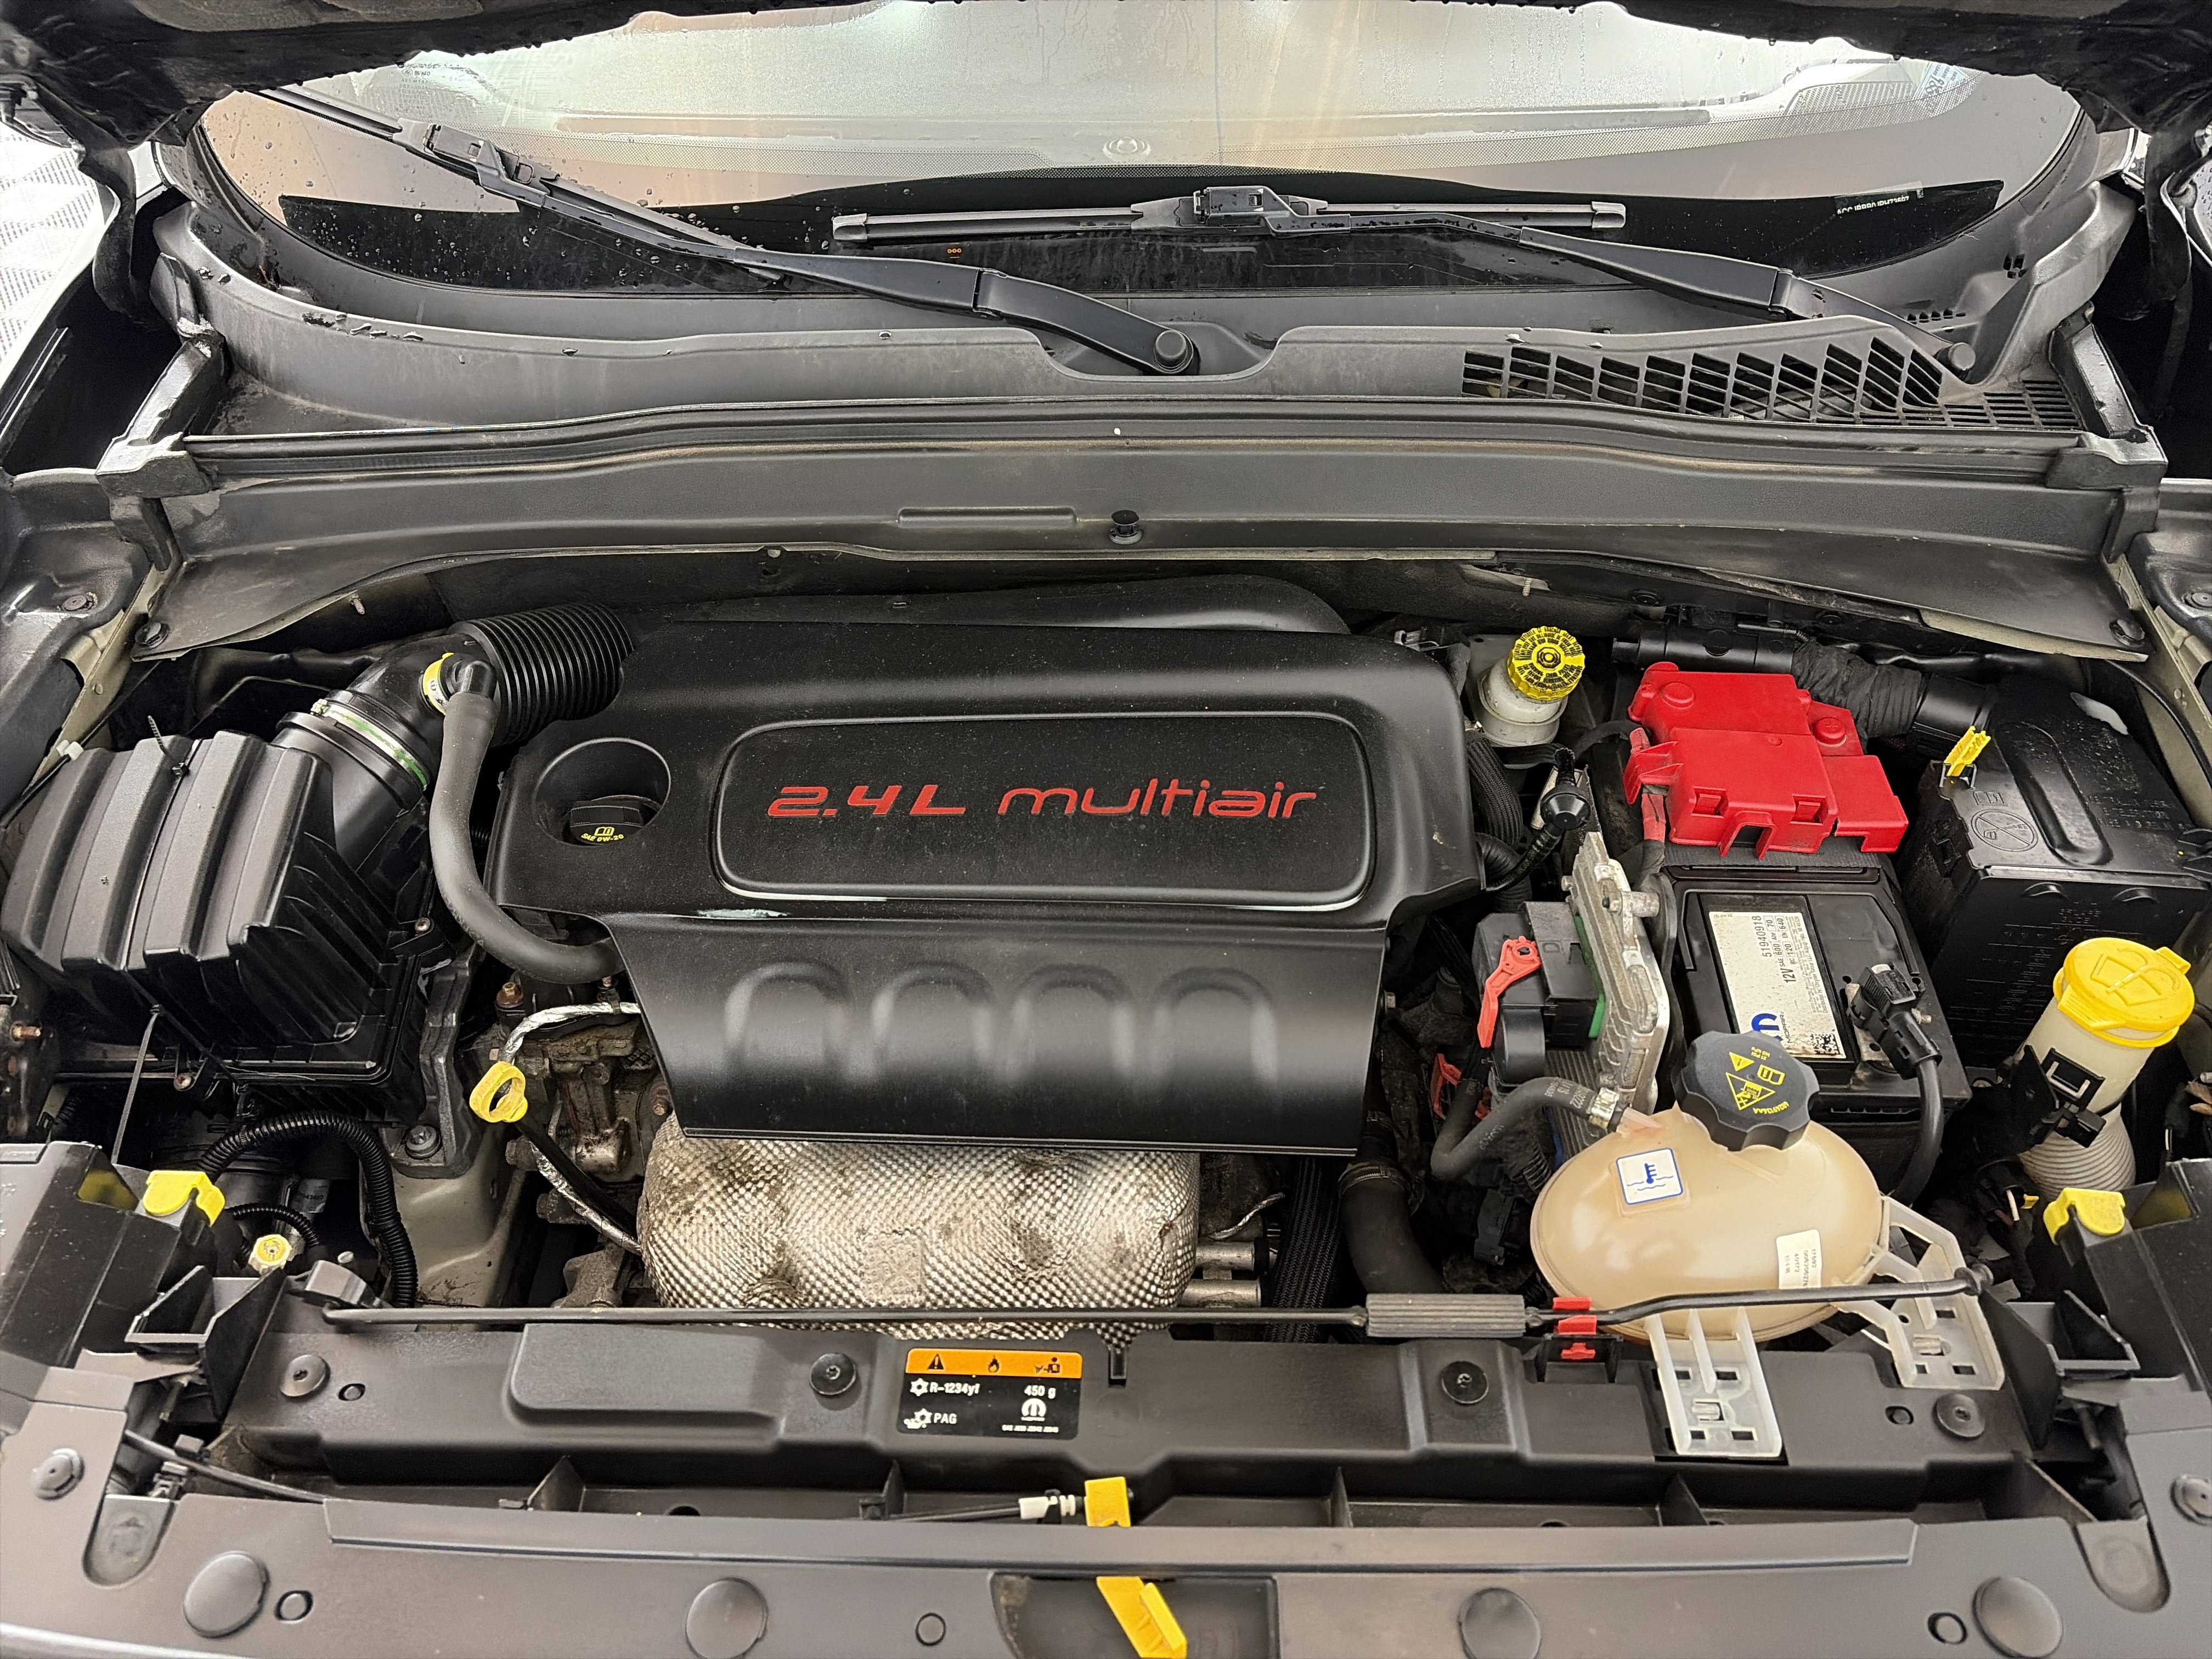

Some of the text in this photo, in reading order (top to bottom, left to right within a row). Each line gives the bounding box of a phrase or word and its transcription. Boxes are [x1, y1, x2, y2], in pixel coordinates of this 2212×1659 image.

[997, 778, 1317, 818] multiair
[580, 833, 624, 842] SAE 0W-20
[1777, 918, 1786, 929] 640
[1752, 916, 1772, 957] 51940918
[1773, 944, 1782, 955] 600
[1785, 944, 1793, 955] 120
[1780, 968, 1797, 983] 12V
[1780, 1014, 1793, 1043] MOPAR
[929, 1382, 980, 1397] R-1234yf
[1024, 1385, 1056, 1399] 450 g
[933, 1412, 957, 1424] PAG
